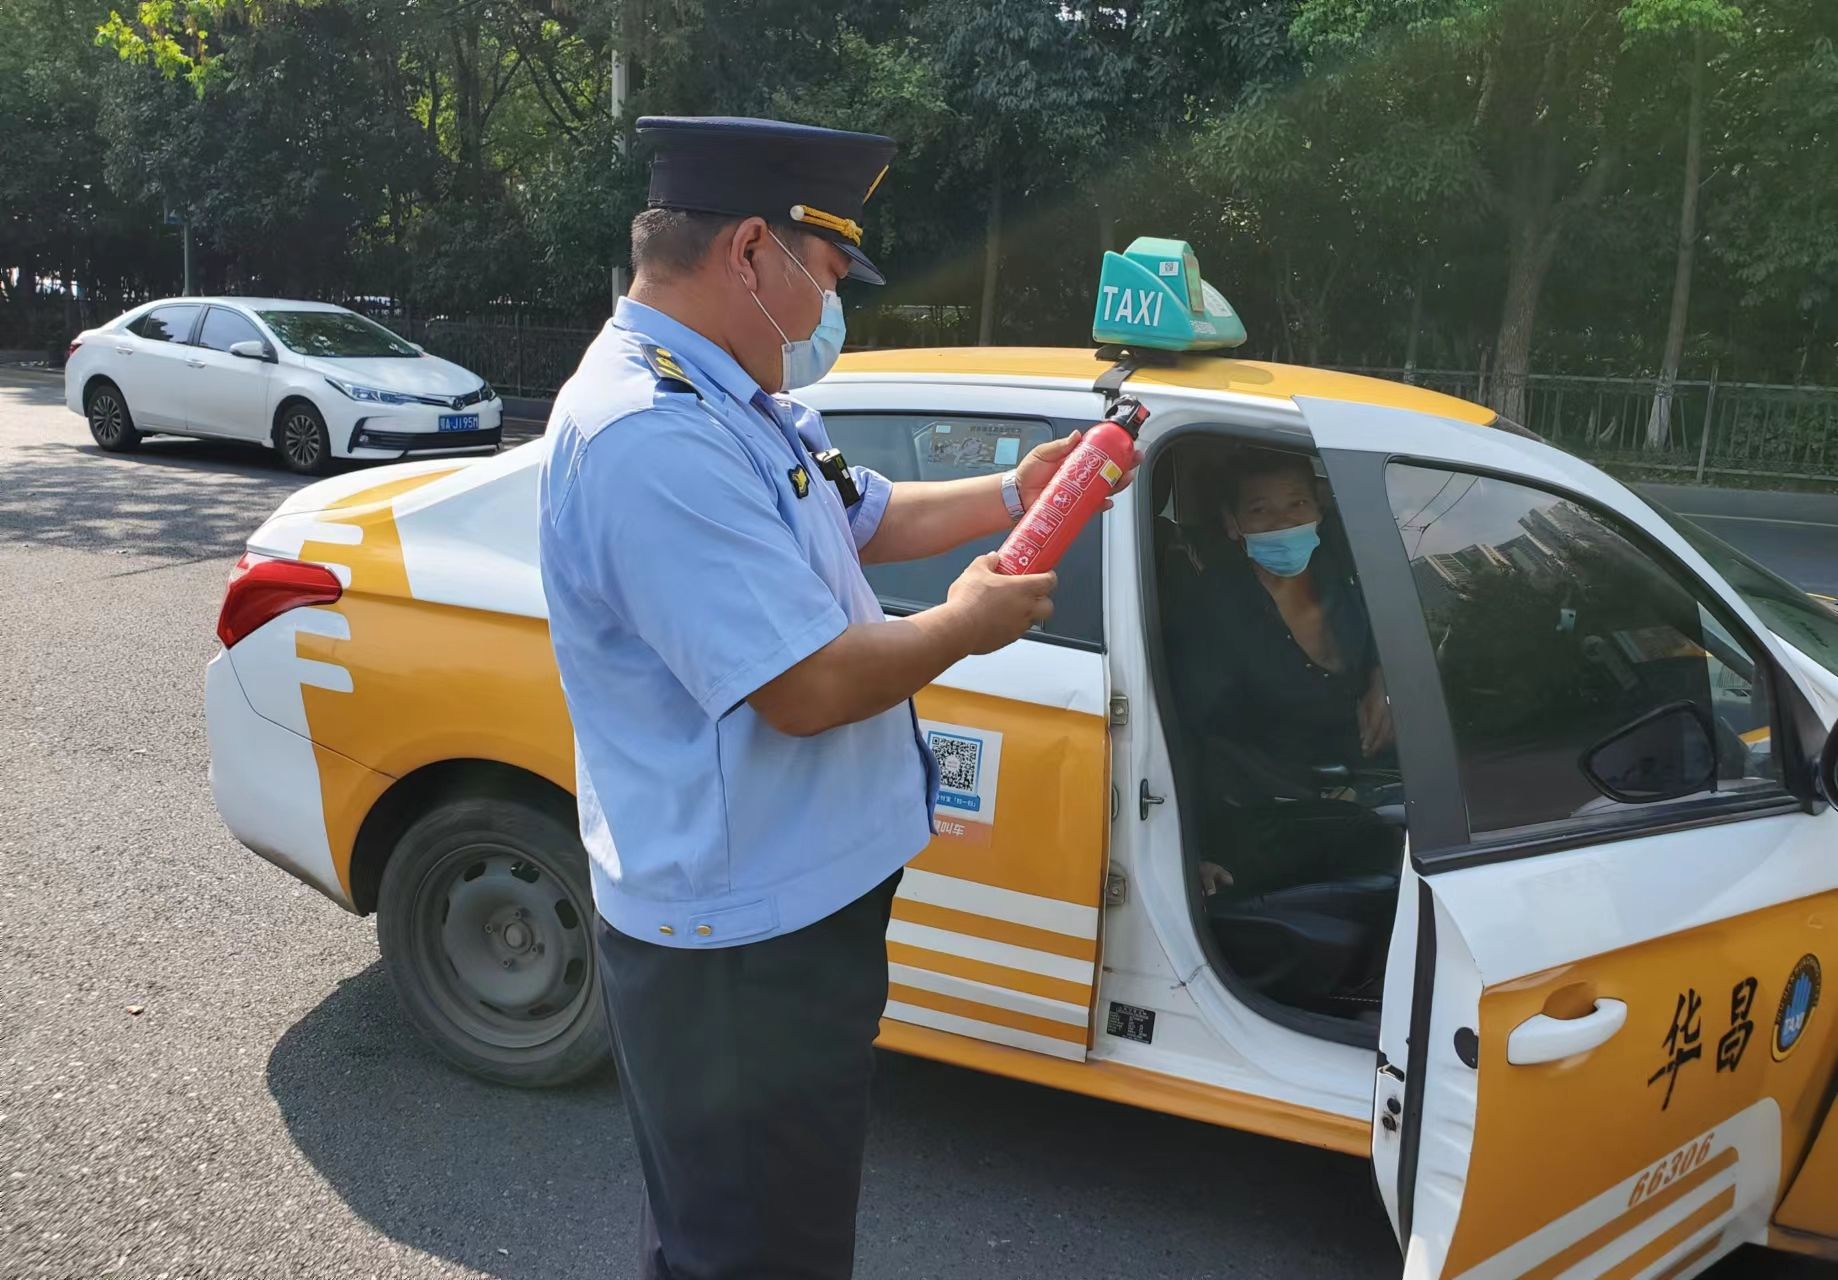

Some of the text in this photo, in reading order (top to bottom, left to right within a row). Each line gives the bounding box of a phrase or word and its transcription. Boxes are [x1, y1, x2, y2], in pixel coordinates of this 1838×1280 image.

[1103, 285, 1164, 327] TAXI
[1647, 976, 1758, 1111] 华昌
[1627, 1131, 1714, 1208] 66306
